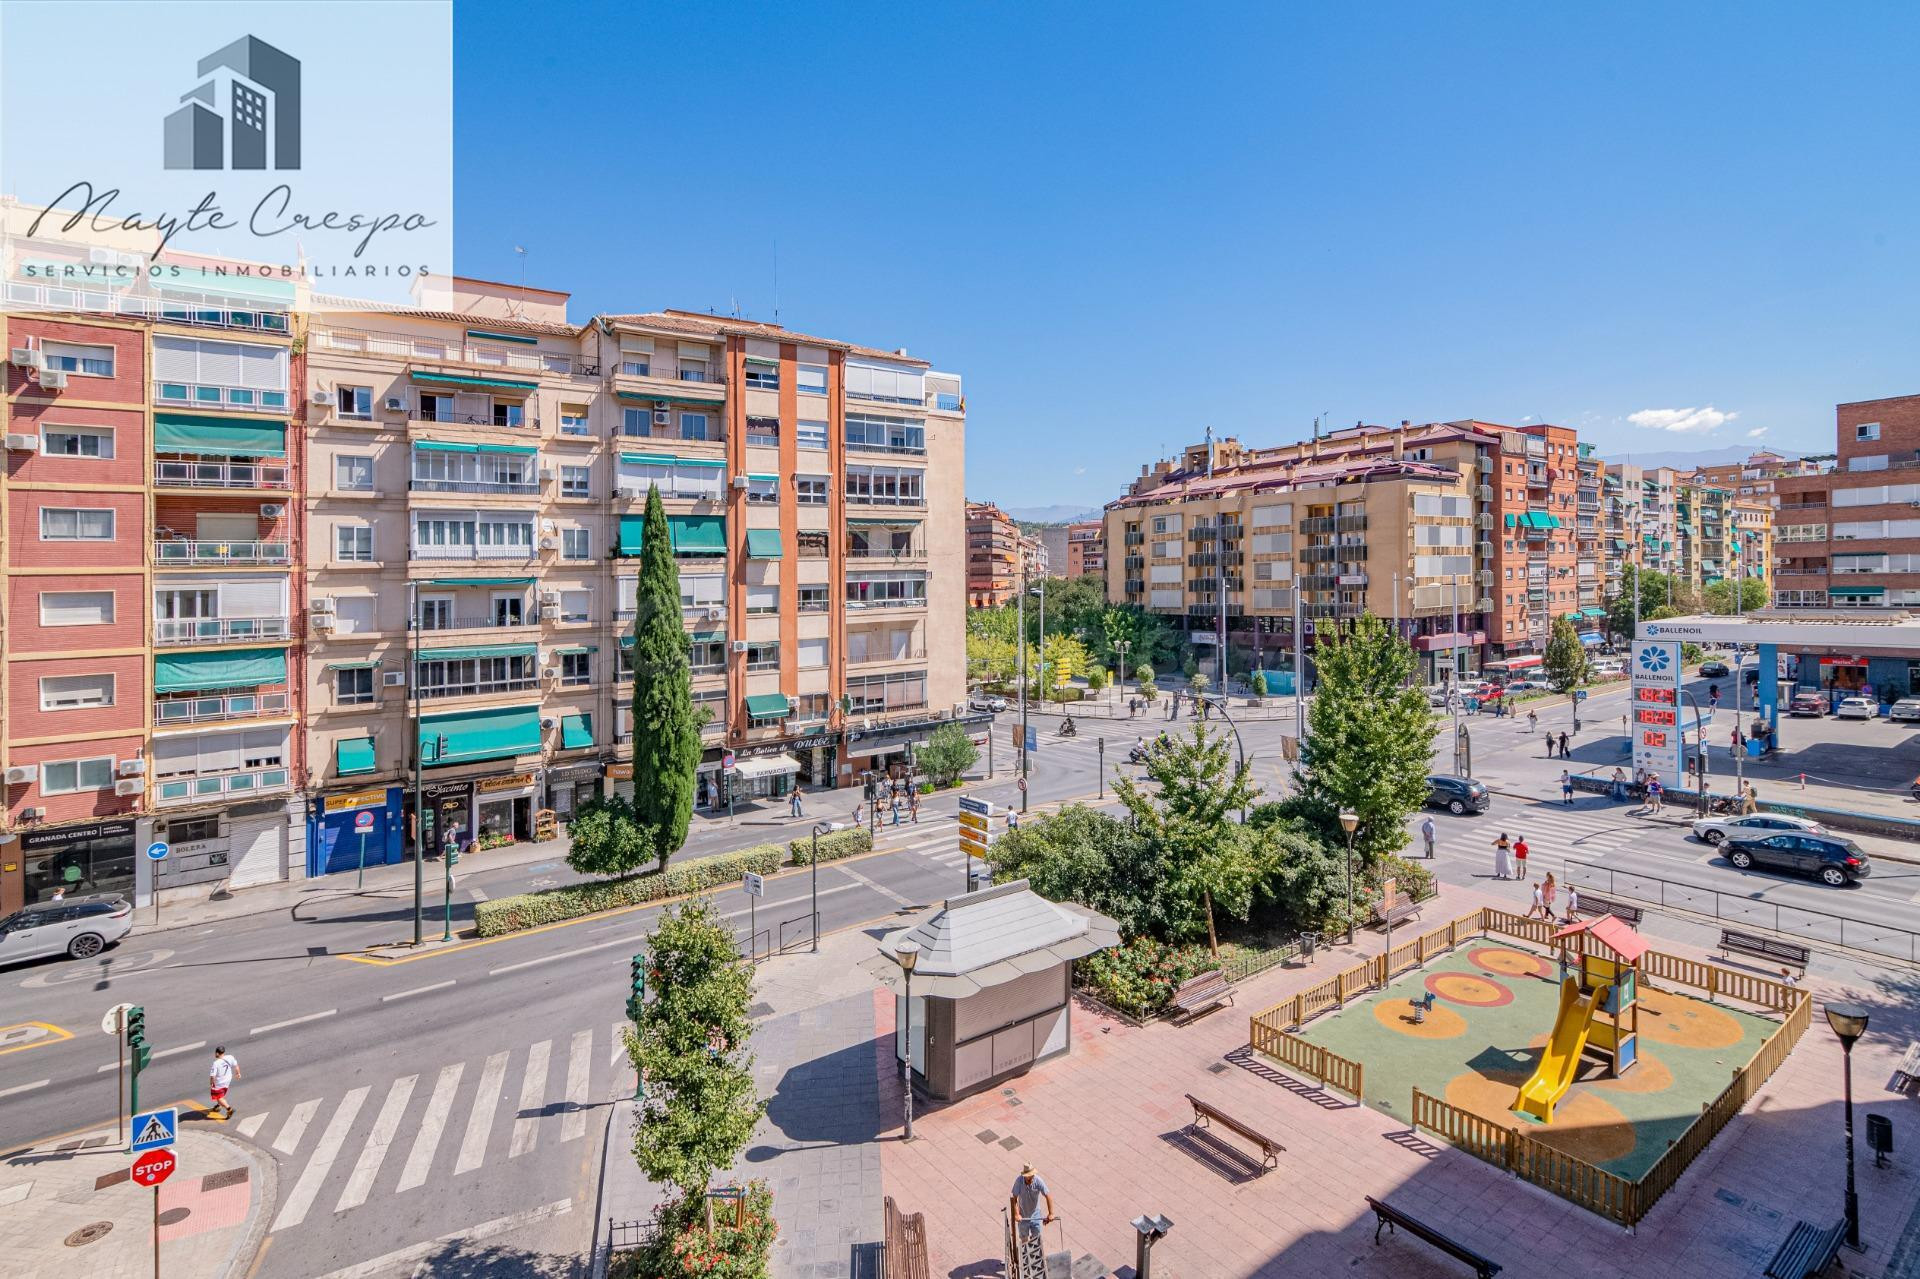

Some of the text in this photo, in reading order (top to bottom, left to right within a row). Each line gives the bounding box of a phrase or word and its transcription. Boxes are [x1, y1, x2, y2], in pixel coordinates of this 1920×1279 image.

[741, 748, 752, 756] La
[754, 746, 777, 755] Botica
[779, 743, 788, 751] de
[757, 768, 788, 776] FARMACIA
[29, 829, 98, 844] GRANADA CENTRO
[223, 1064, 229, 1076] 7
[135, 1160, 173, 1176] STOP
